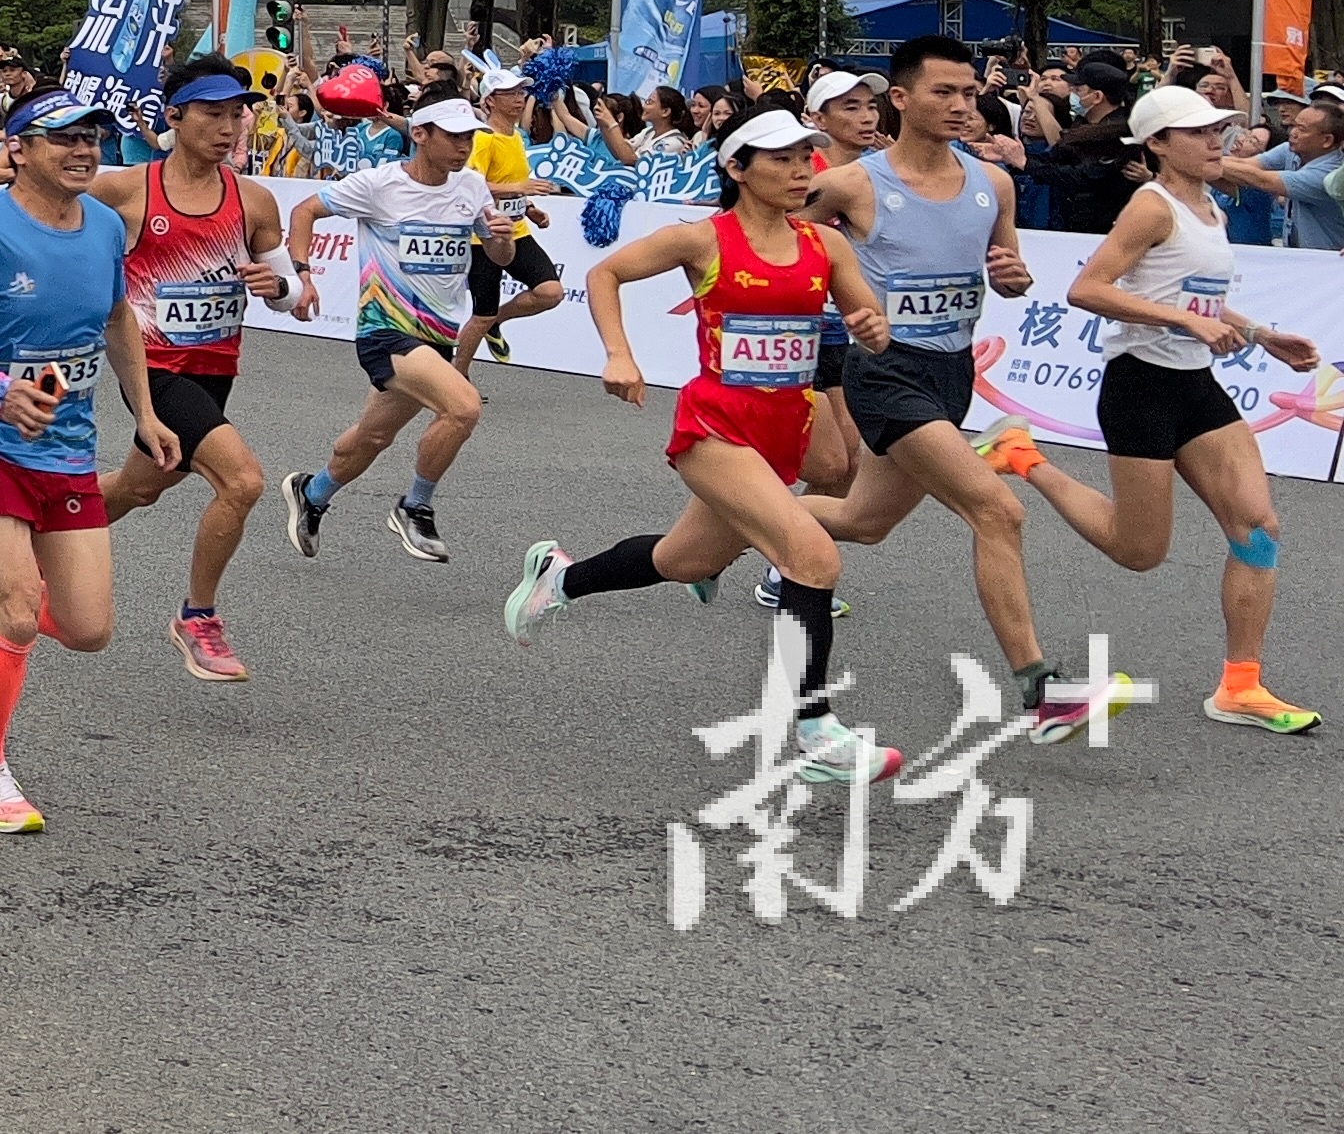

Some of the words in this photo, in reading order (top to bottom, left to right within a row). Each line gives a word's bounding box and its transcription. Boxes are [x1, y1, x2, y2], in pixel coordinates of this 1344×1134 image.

[334, 68, 374, 97] 3:00
[405, 237, 467, 258] A1266
[166, 299, 239, 323] A1254
[897, 290, 979, 316] A1243
[732, 337, 816, 362] A1581
